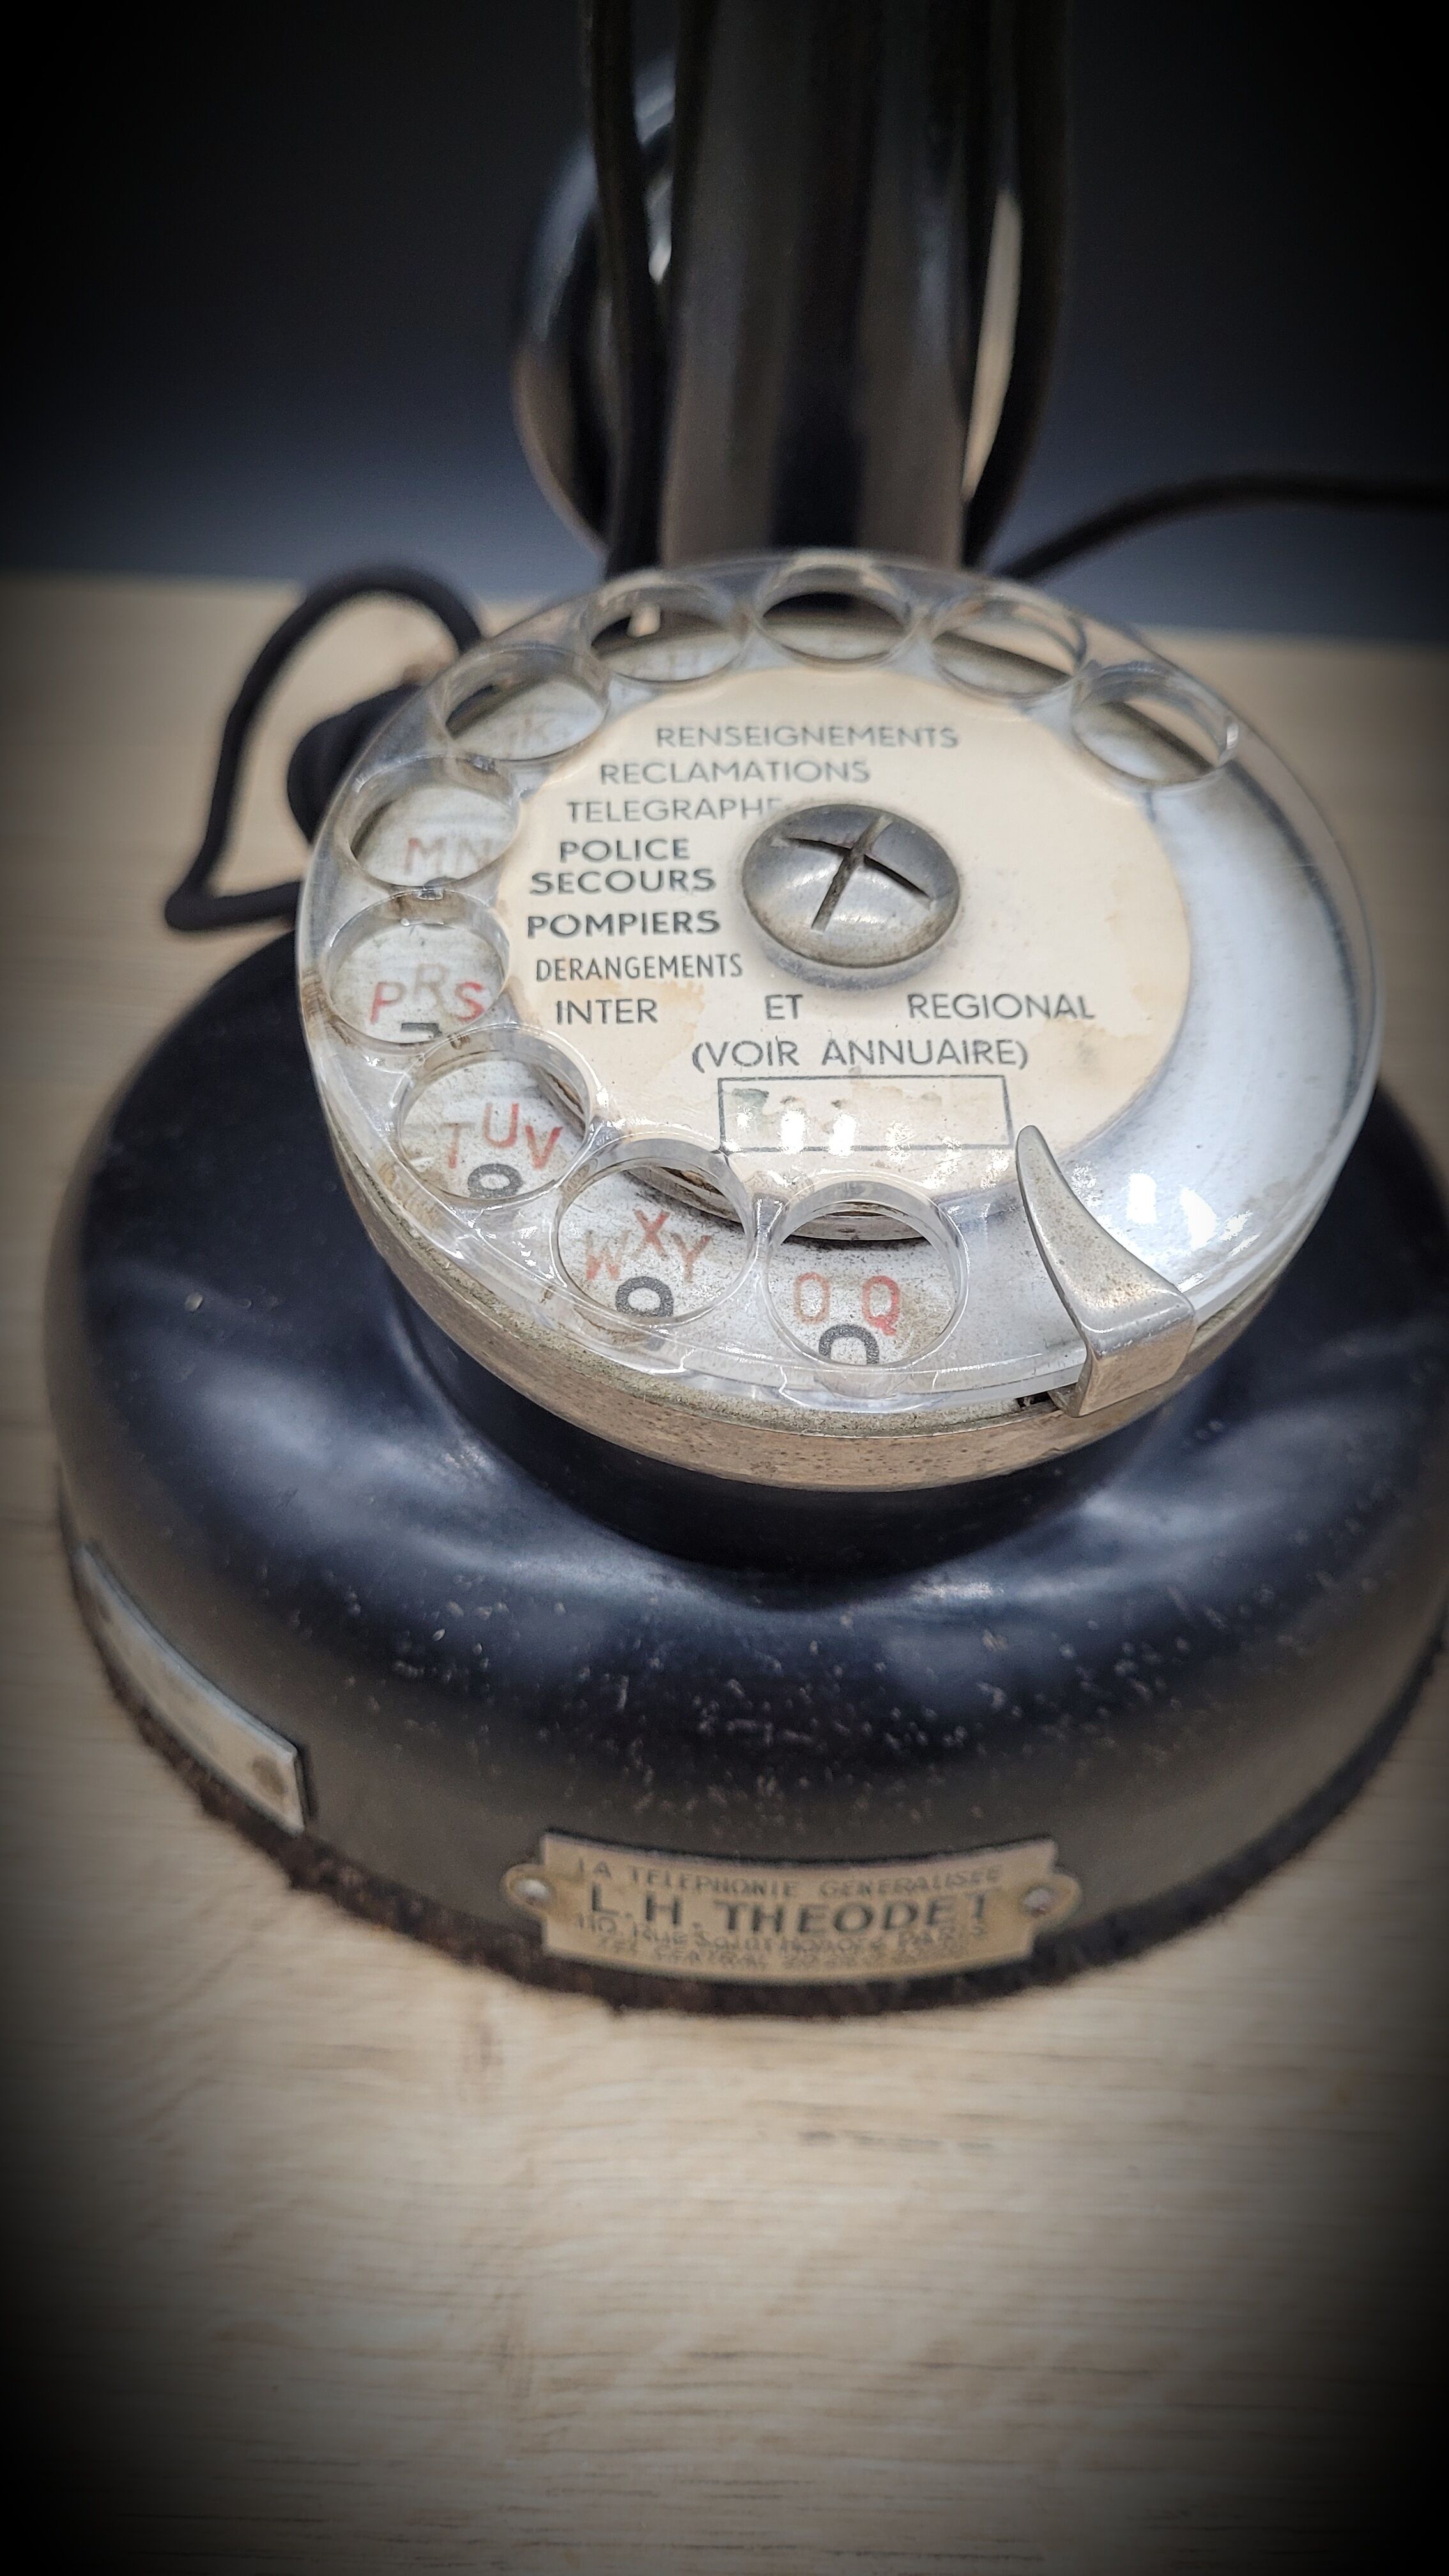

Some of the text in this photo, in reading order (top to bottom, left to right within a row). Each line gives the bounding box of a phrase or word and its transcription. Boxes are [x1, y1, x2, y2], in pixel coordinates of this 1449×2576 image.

[656, 725, 958, 748] RENSEIGNEMENTS
[599, 760, 870, 785] RECLAMATIONS
[560, 838, 690, 862] POLICE
[530, 869, 716, 895] SECOURS
[528, 910, 720, 938] POMPIERS
[535, 953, 743, 982] DERANGEMENTS
[556, 993, 1096, 1024] INTER ET REGIONAL
[691, 1039, 1029, 1072] (VOIR ANNUAIRE)
